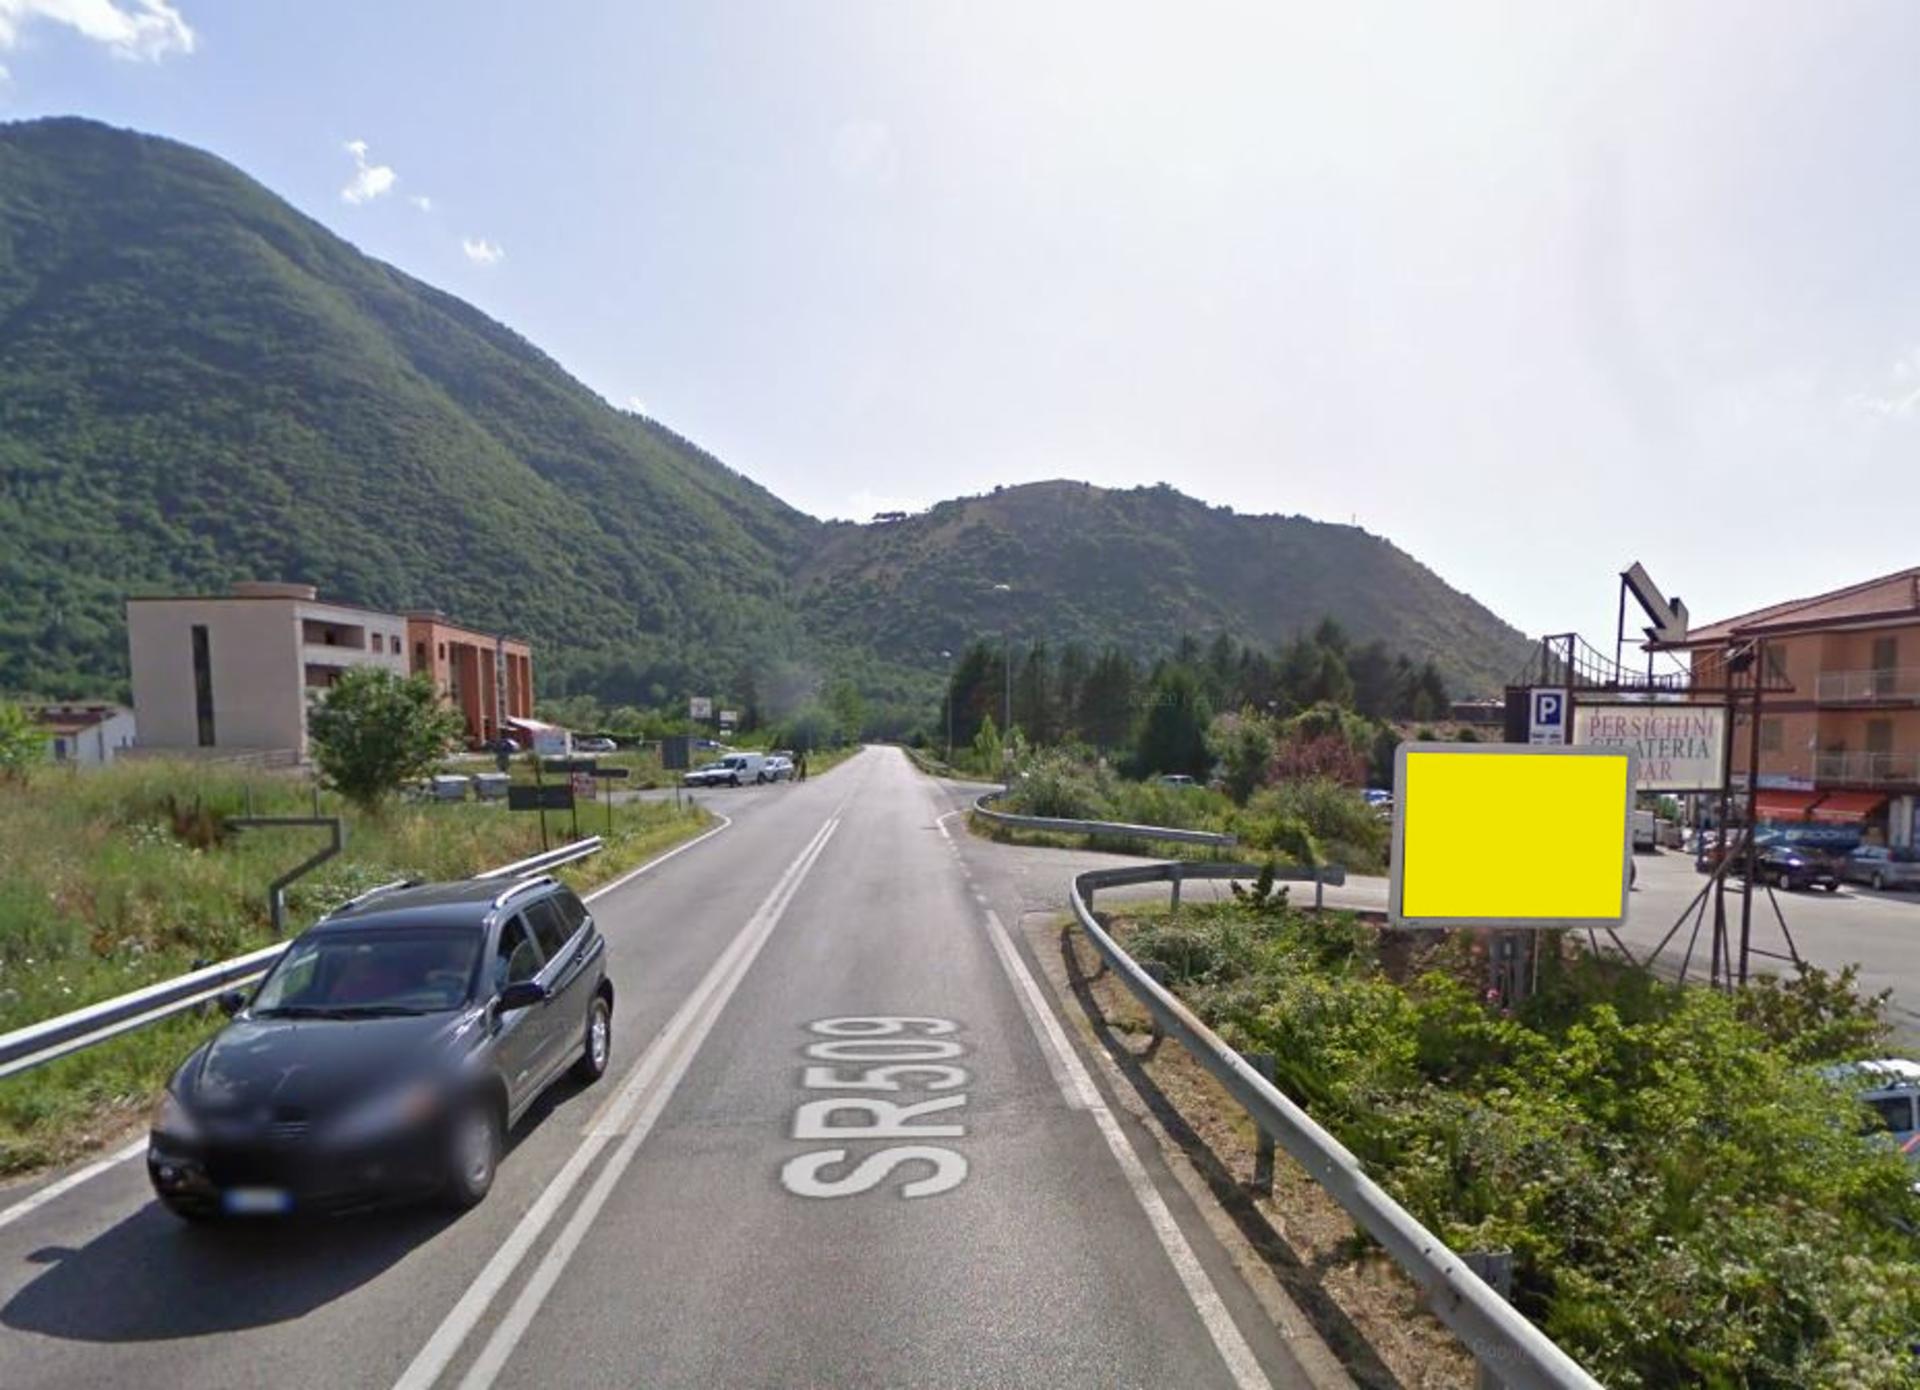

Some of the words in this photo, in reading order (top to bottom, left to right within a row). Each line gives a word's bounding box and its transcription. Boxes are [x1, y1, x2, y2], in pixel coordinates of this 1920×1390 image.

[1540, 696, 1557, 722] P
[1589, 715, 1713, 738] PERSICHINI
[781, 1016, 968, 1198] SR509
